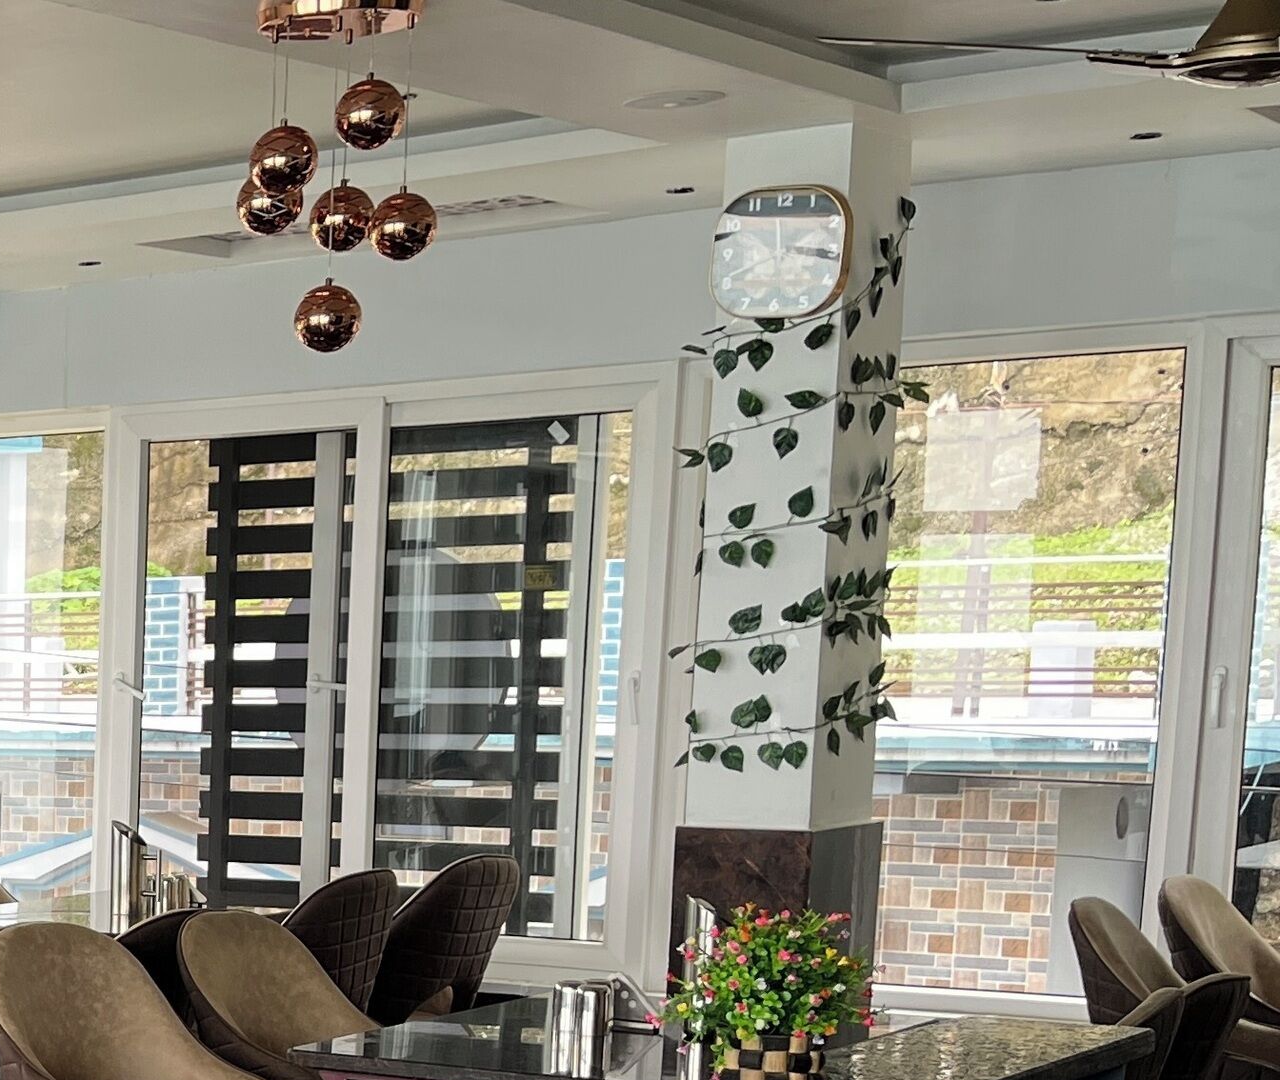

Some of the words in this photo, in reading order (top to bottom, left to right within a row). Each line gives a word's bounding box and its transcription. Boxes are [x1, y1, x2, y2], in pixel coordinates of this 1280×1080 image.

[749, 198, 761, 212] 11
[777, 193, 793, 207] 12
[725, 218, 741, 232] 10
[828, 216, 840, 228] 2
[722, 249, 733, 261] 9
[827, 244, 839, 257] 3
[721, 276, 732, 290] 8
[822, 273, 834, 287] 4
[741, 297, 752, 310] 7
[768, 298, 780, 312] 6
[798, 296, 809, 309] 5
